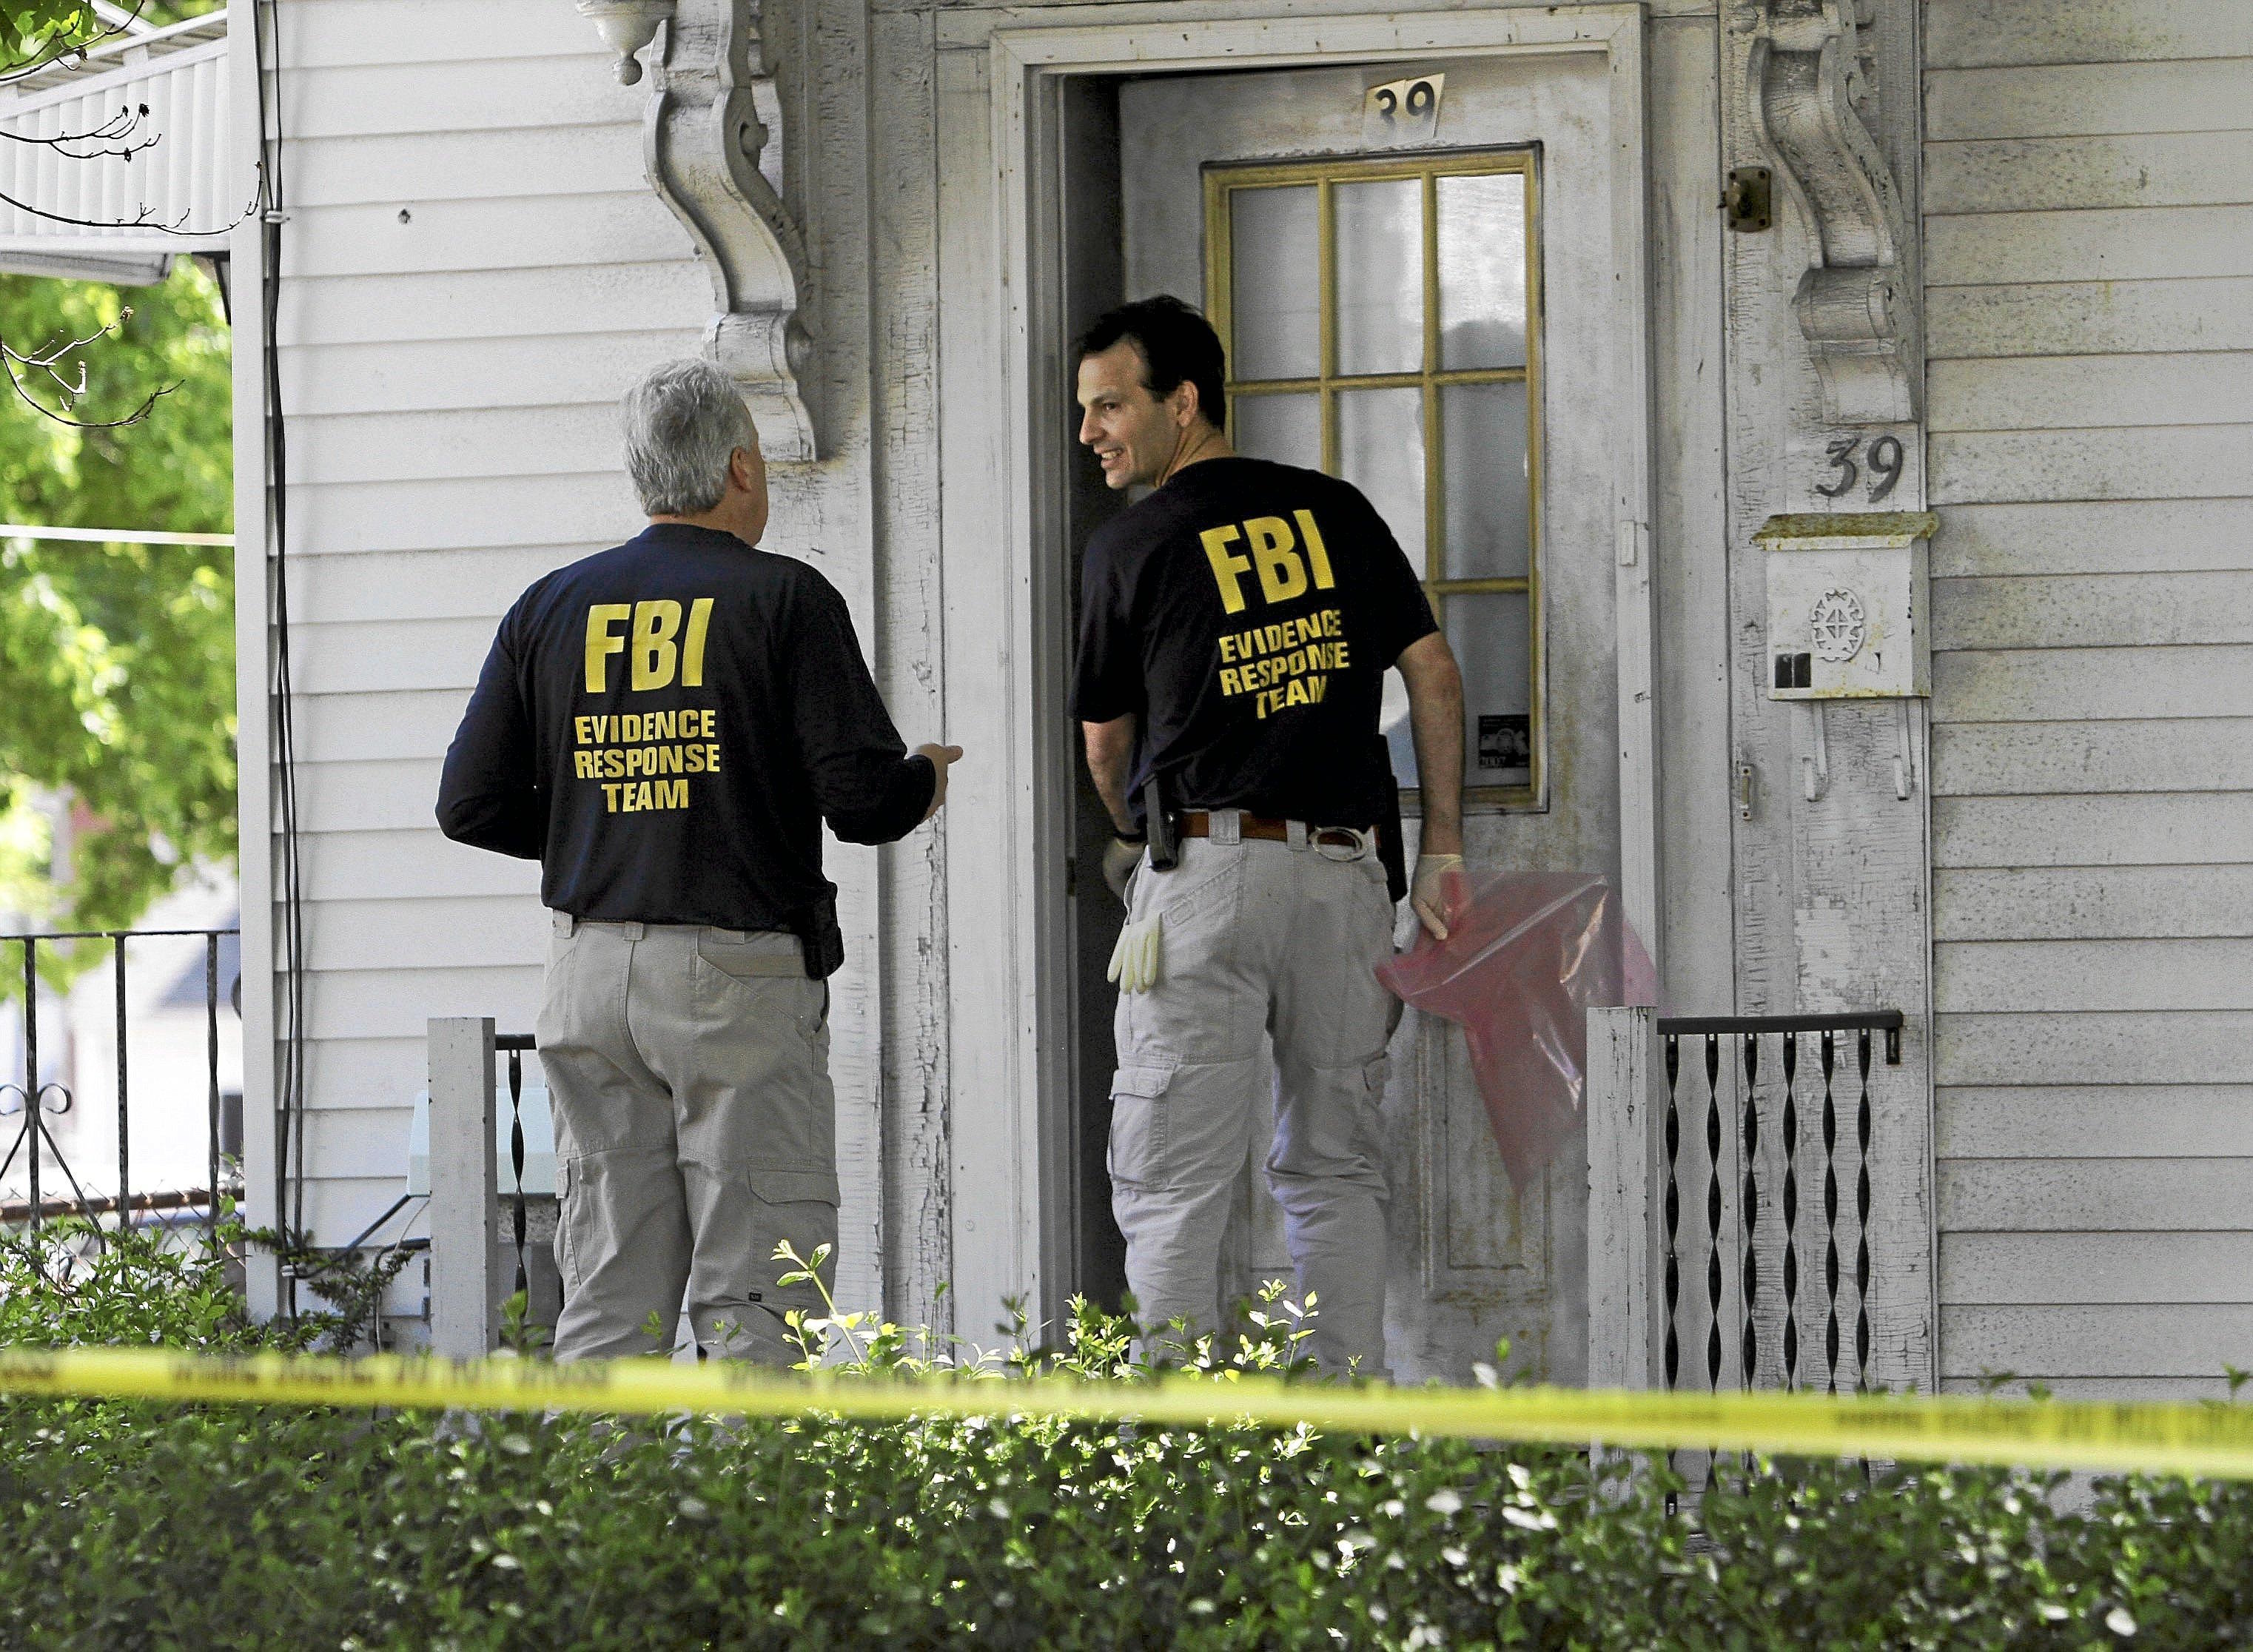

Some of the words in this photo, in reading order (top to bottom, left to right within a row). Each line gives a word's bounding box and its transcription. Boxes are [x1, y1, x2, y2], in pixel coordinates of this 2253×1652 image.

[1816, 435, 1903, 503] 39
[1199, 508, 1334, 615] FBI
[585, 597, 714, 693] FBI
[1218, 609, 1342, 663] EVIDENCE
[1219, 641, 1351, 696] RESPONSE
[1255, 675, 1327, 719] TEAM
[574, 709, 716, 745] EVIDENCE
[574, 743, 720, 779] RESPONSE
[601, 779, 689, 813] TEAM
